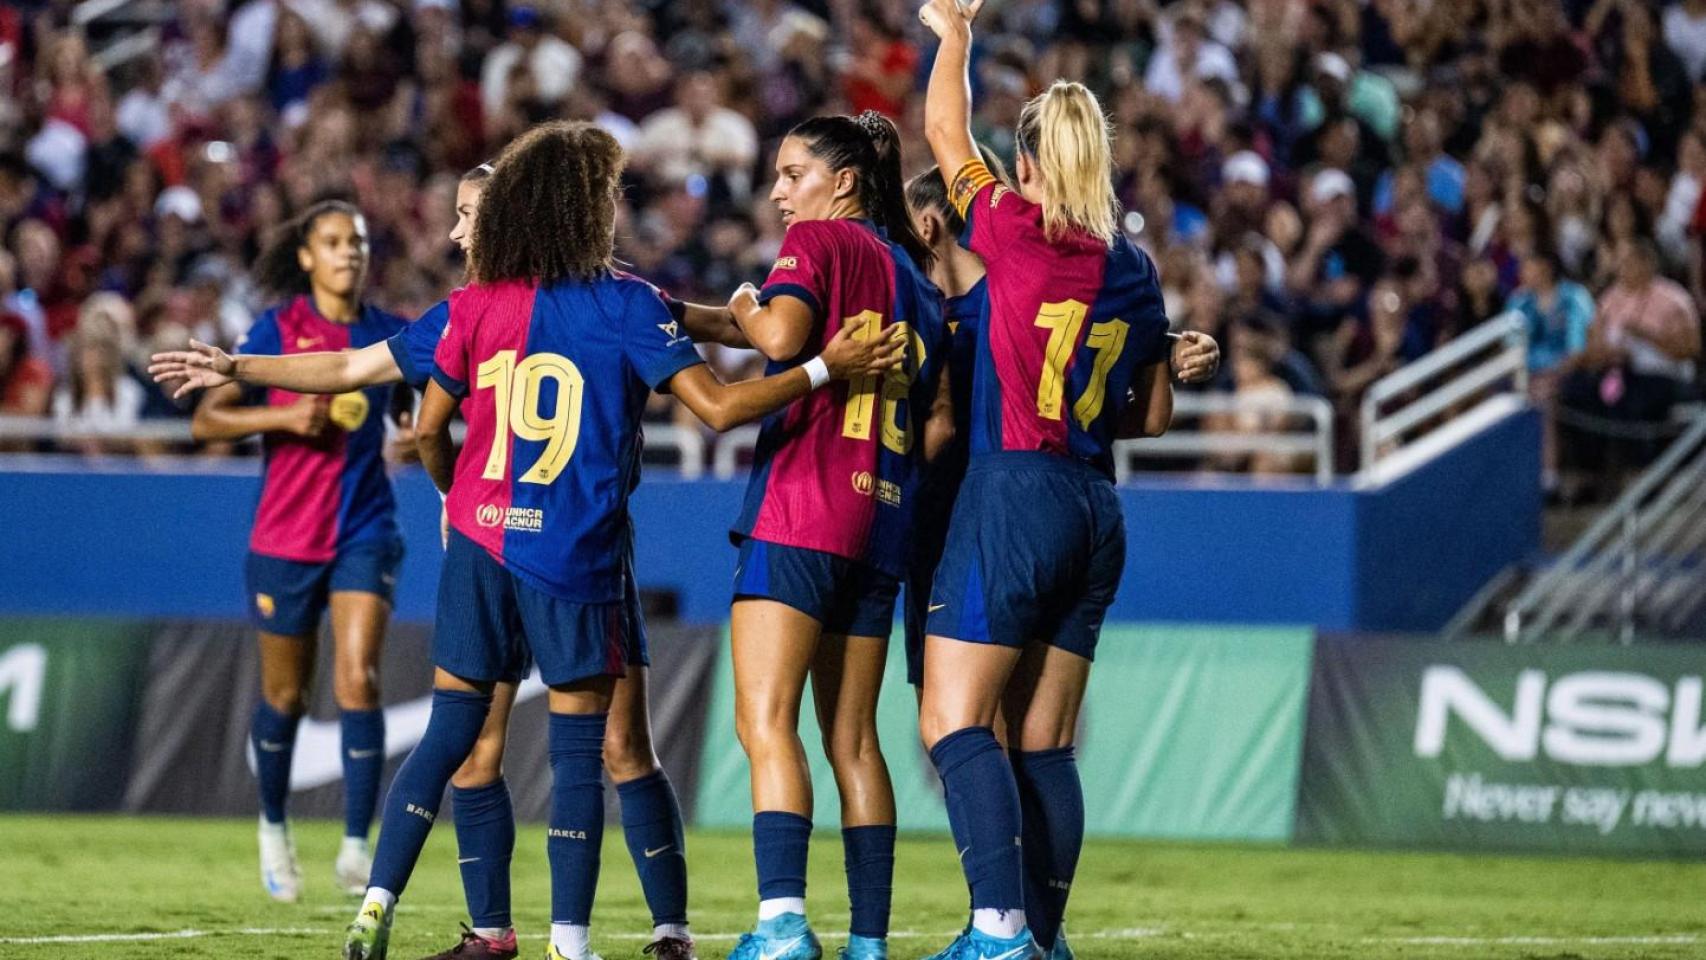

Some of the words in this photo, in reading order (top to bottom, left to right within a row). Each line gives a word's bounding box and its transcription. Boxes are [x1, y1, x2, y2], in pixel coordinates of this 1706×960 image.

[1034, 298, 1130, 432] 11
[476, 350, 584, 485] 19
[504, 516, 542, 528] ACNUR
[505, 507, 543, 518] UNHCR
[1443, 774, 1556, 822] Never
[1562, 786, 1630, 834] say
